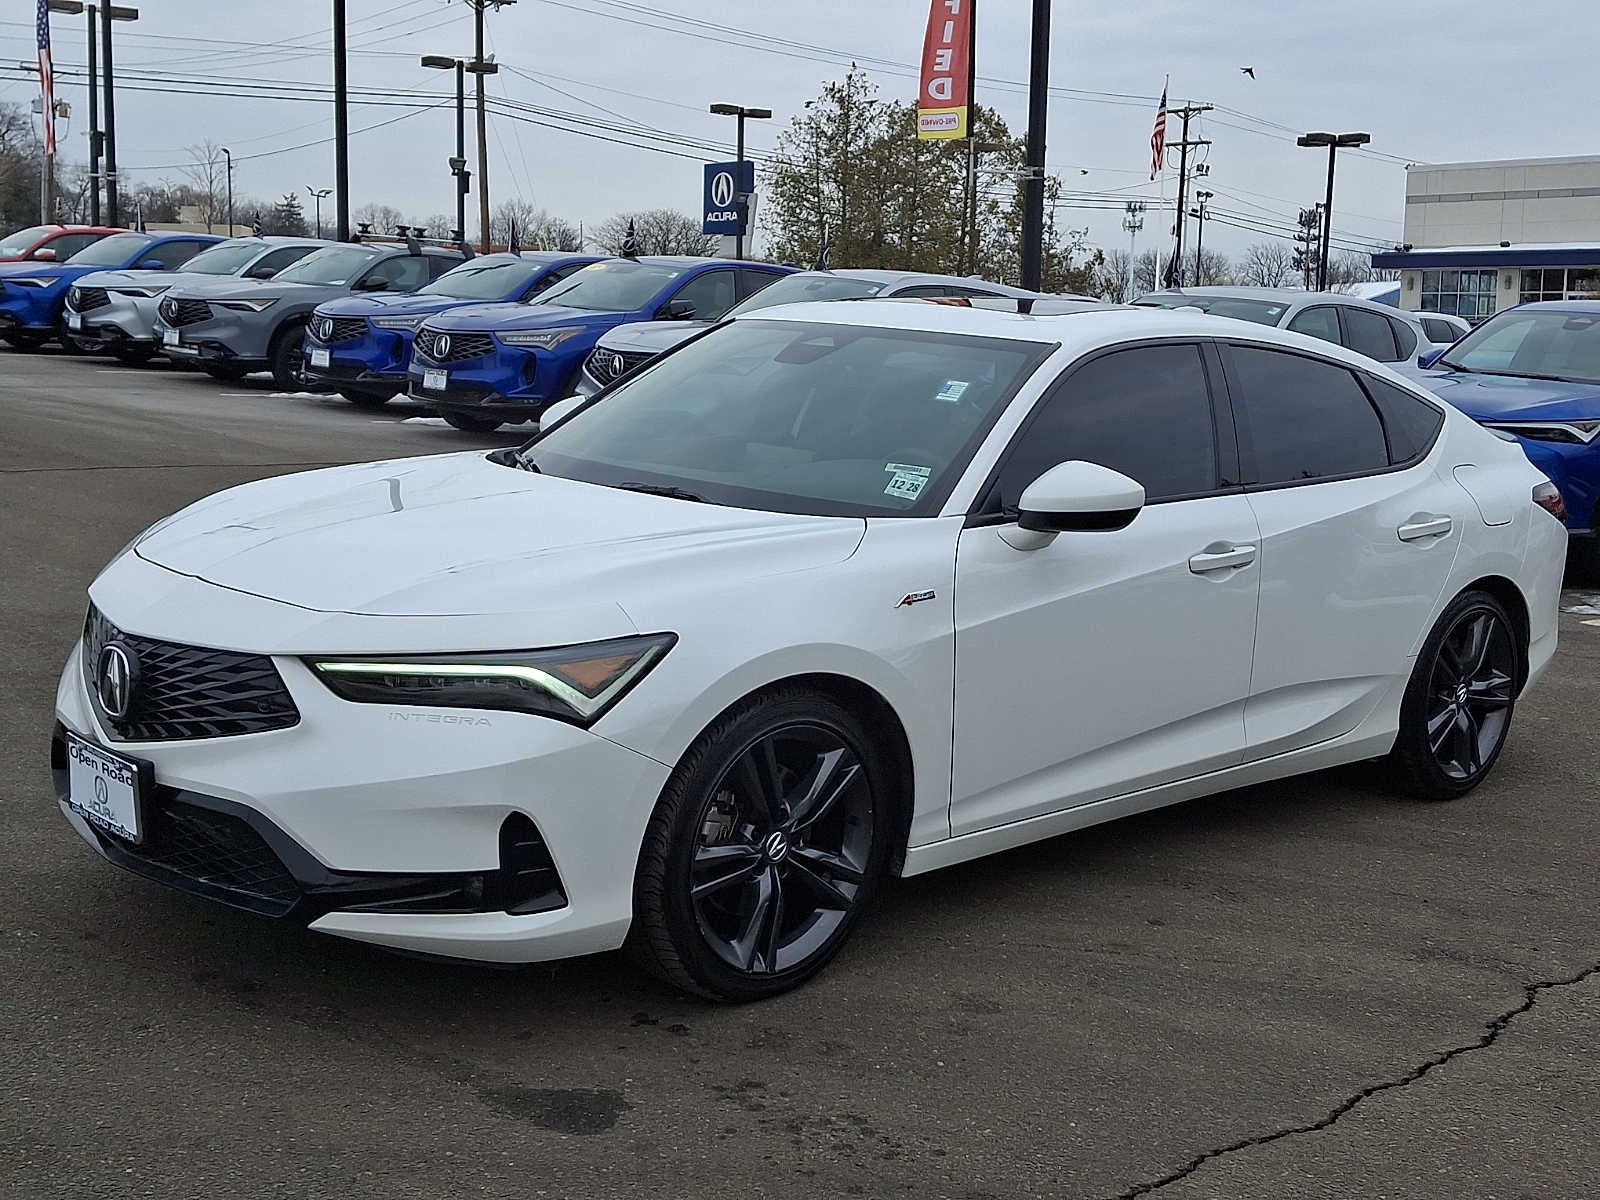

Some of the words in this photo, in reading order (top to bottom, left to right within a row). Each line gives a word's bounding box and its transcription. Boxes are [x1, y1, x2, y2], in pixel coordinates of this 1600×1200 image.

[706, 211, 738, 222] ACURA
[388, 712, 493, 727] INTEGRA
[70, 745, 98, 771] Open
